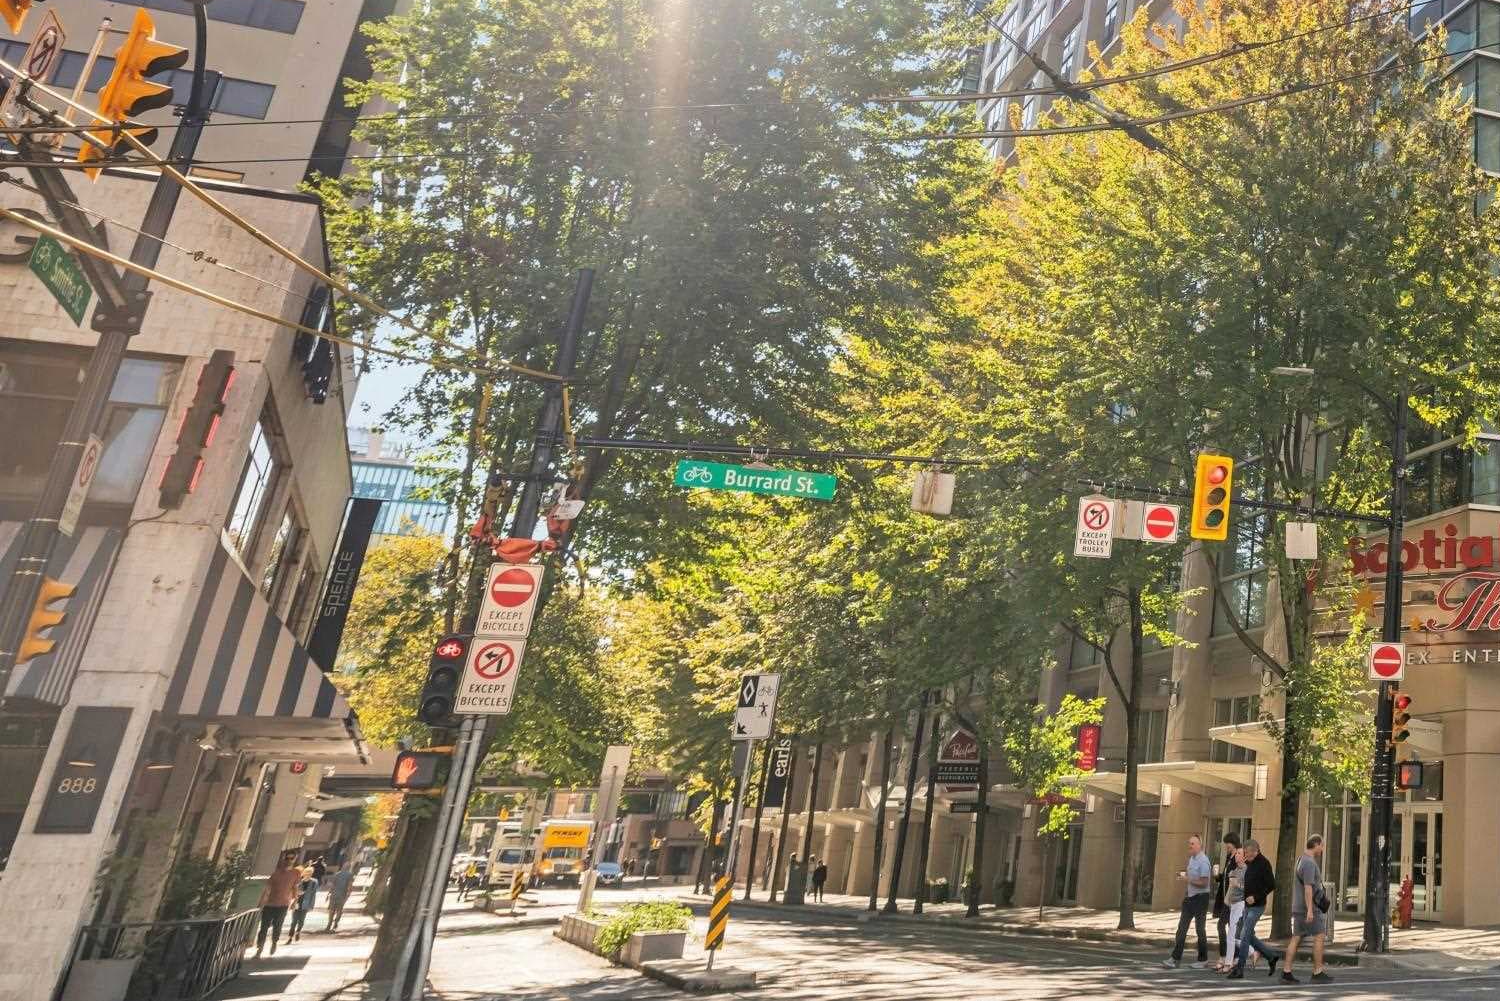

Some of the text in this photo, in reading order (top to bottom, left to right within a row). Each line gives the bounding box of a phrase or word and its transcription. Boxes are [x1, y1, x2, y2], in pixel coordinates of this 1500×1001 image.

[724, 469, 819, 494] Burrard St.
[1081, 531, 1108, 539] EXCEPT
[1079, 538, 1109, 546] TROLLEY
[489, 611, 523, 620] EXCEPT
[482, 622, 524, 631] BICYCLES
[469, 683, 506, 693] EXCEPT
[460, 696, 509, 707] BICYCLES
[774, 739, 792, 778] earls
[58, 778, 97, 793] 888
